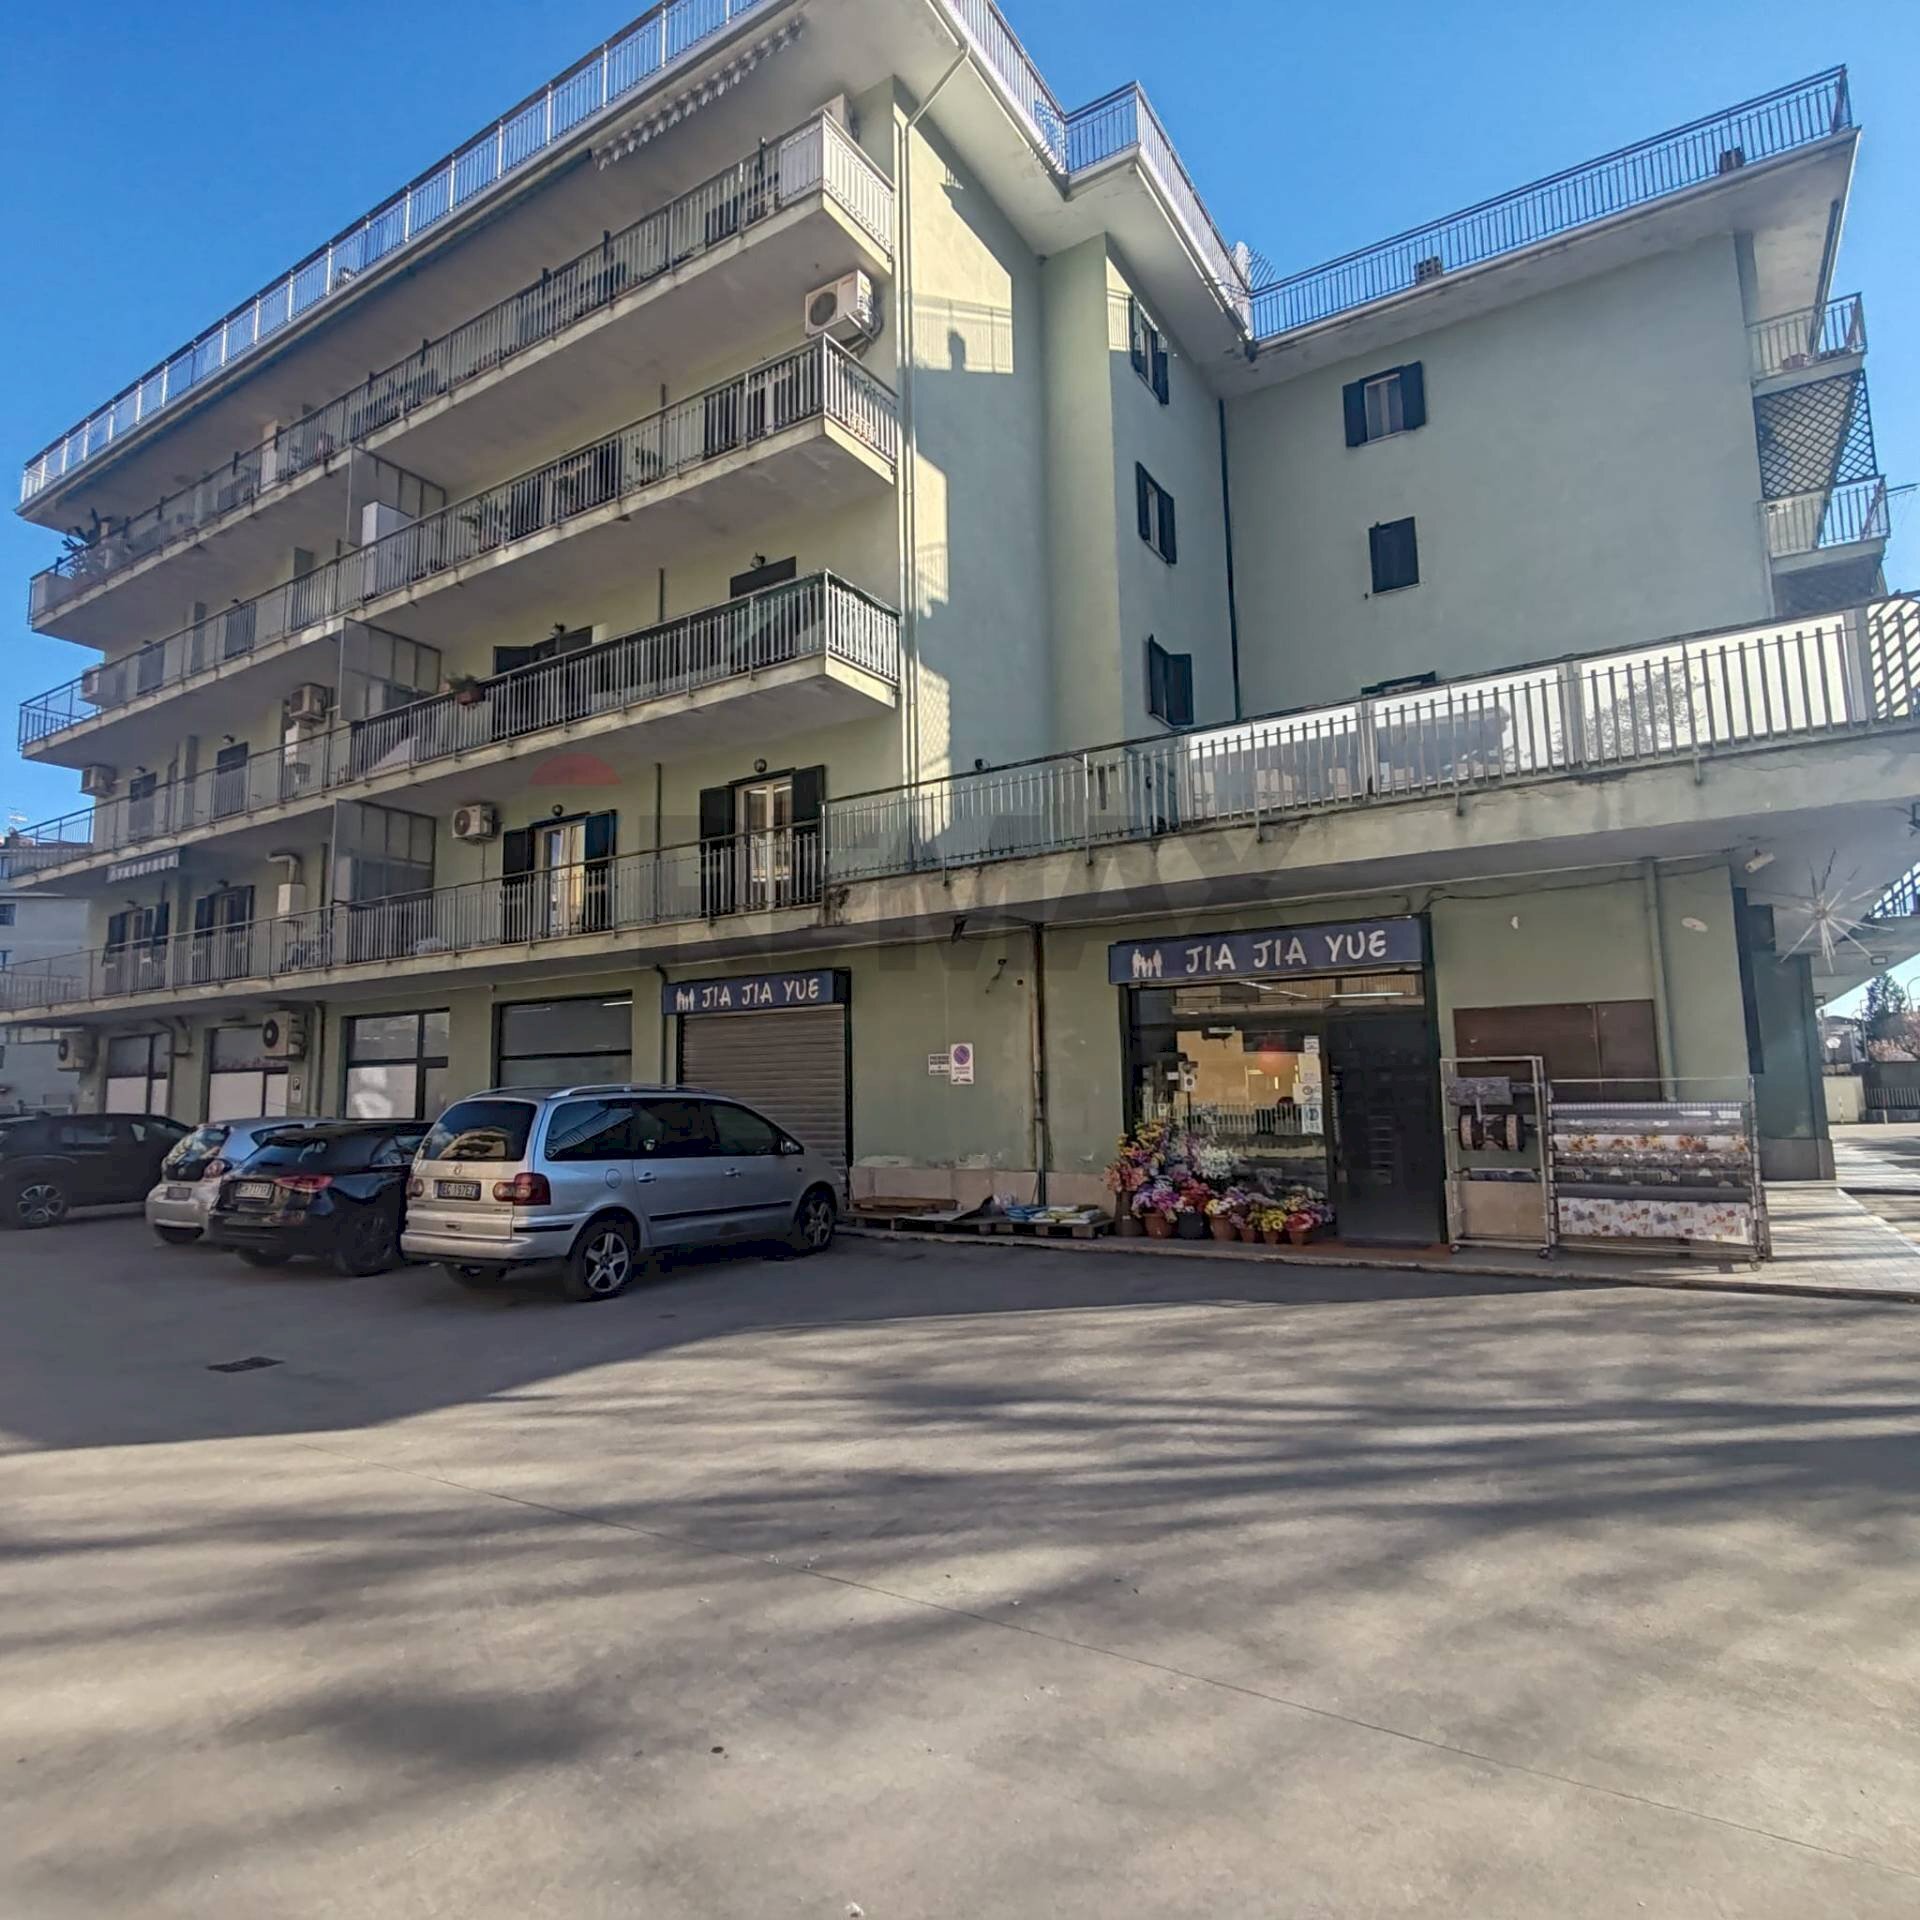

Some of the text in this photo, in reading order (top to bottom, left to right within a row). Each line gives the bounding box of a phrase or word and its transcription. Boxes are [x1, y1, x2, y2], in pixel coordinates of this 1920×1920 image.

[1185, 929, 1387, 973] JIA JIA YUE
[702, 978, 819, 1008] JIA JIA YUE
